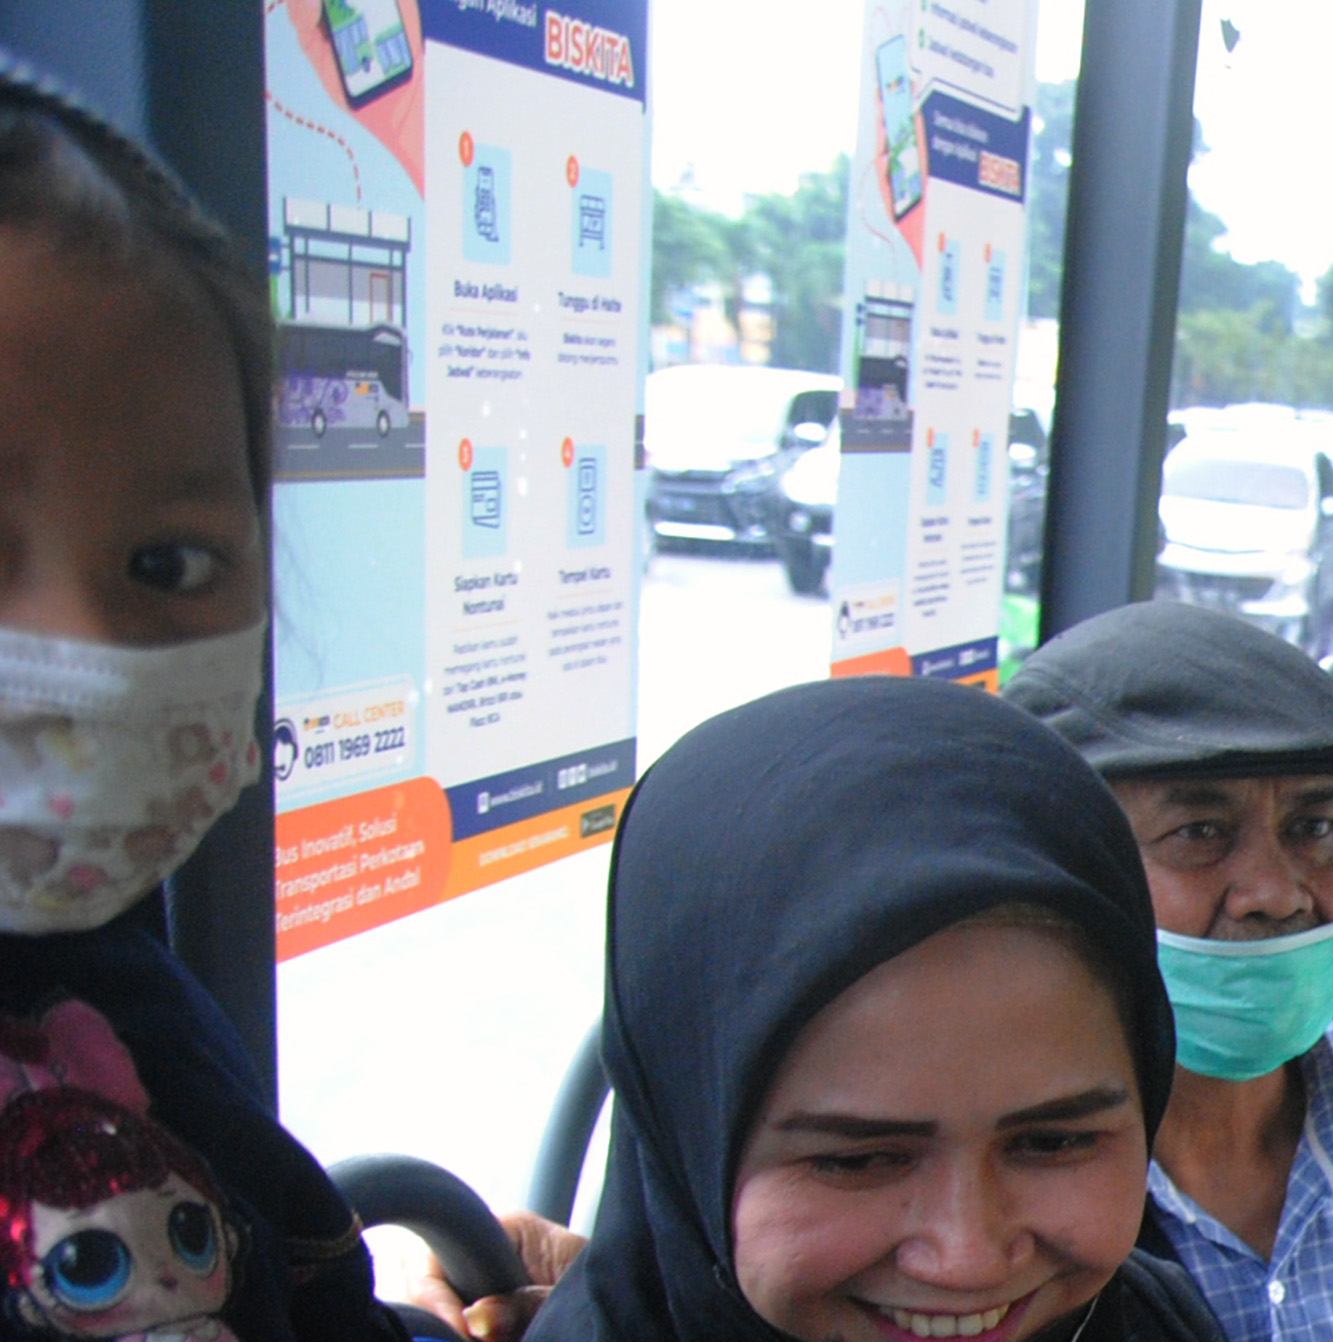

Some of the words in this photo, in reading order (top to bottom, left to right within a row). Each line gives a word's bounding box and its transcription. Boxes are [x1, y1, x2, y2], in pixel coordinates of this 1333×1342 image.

[545, 9, 634, 88] BISKITA
[334, 712, 361, 730] CALL
[364, 701, 404, 723] CENTER
[304, 741, 335, 769] 0811
[338, 734, 370, 761] 1969
[374, 726, 406, 753] 2222
[358, 811, 397, 842] Solusi
[358, 839, 425, 873] Perkotaan
[355, 884, 382, 906] dan
